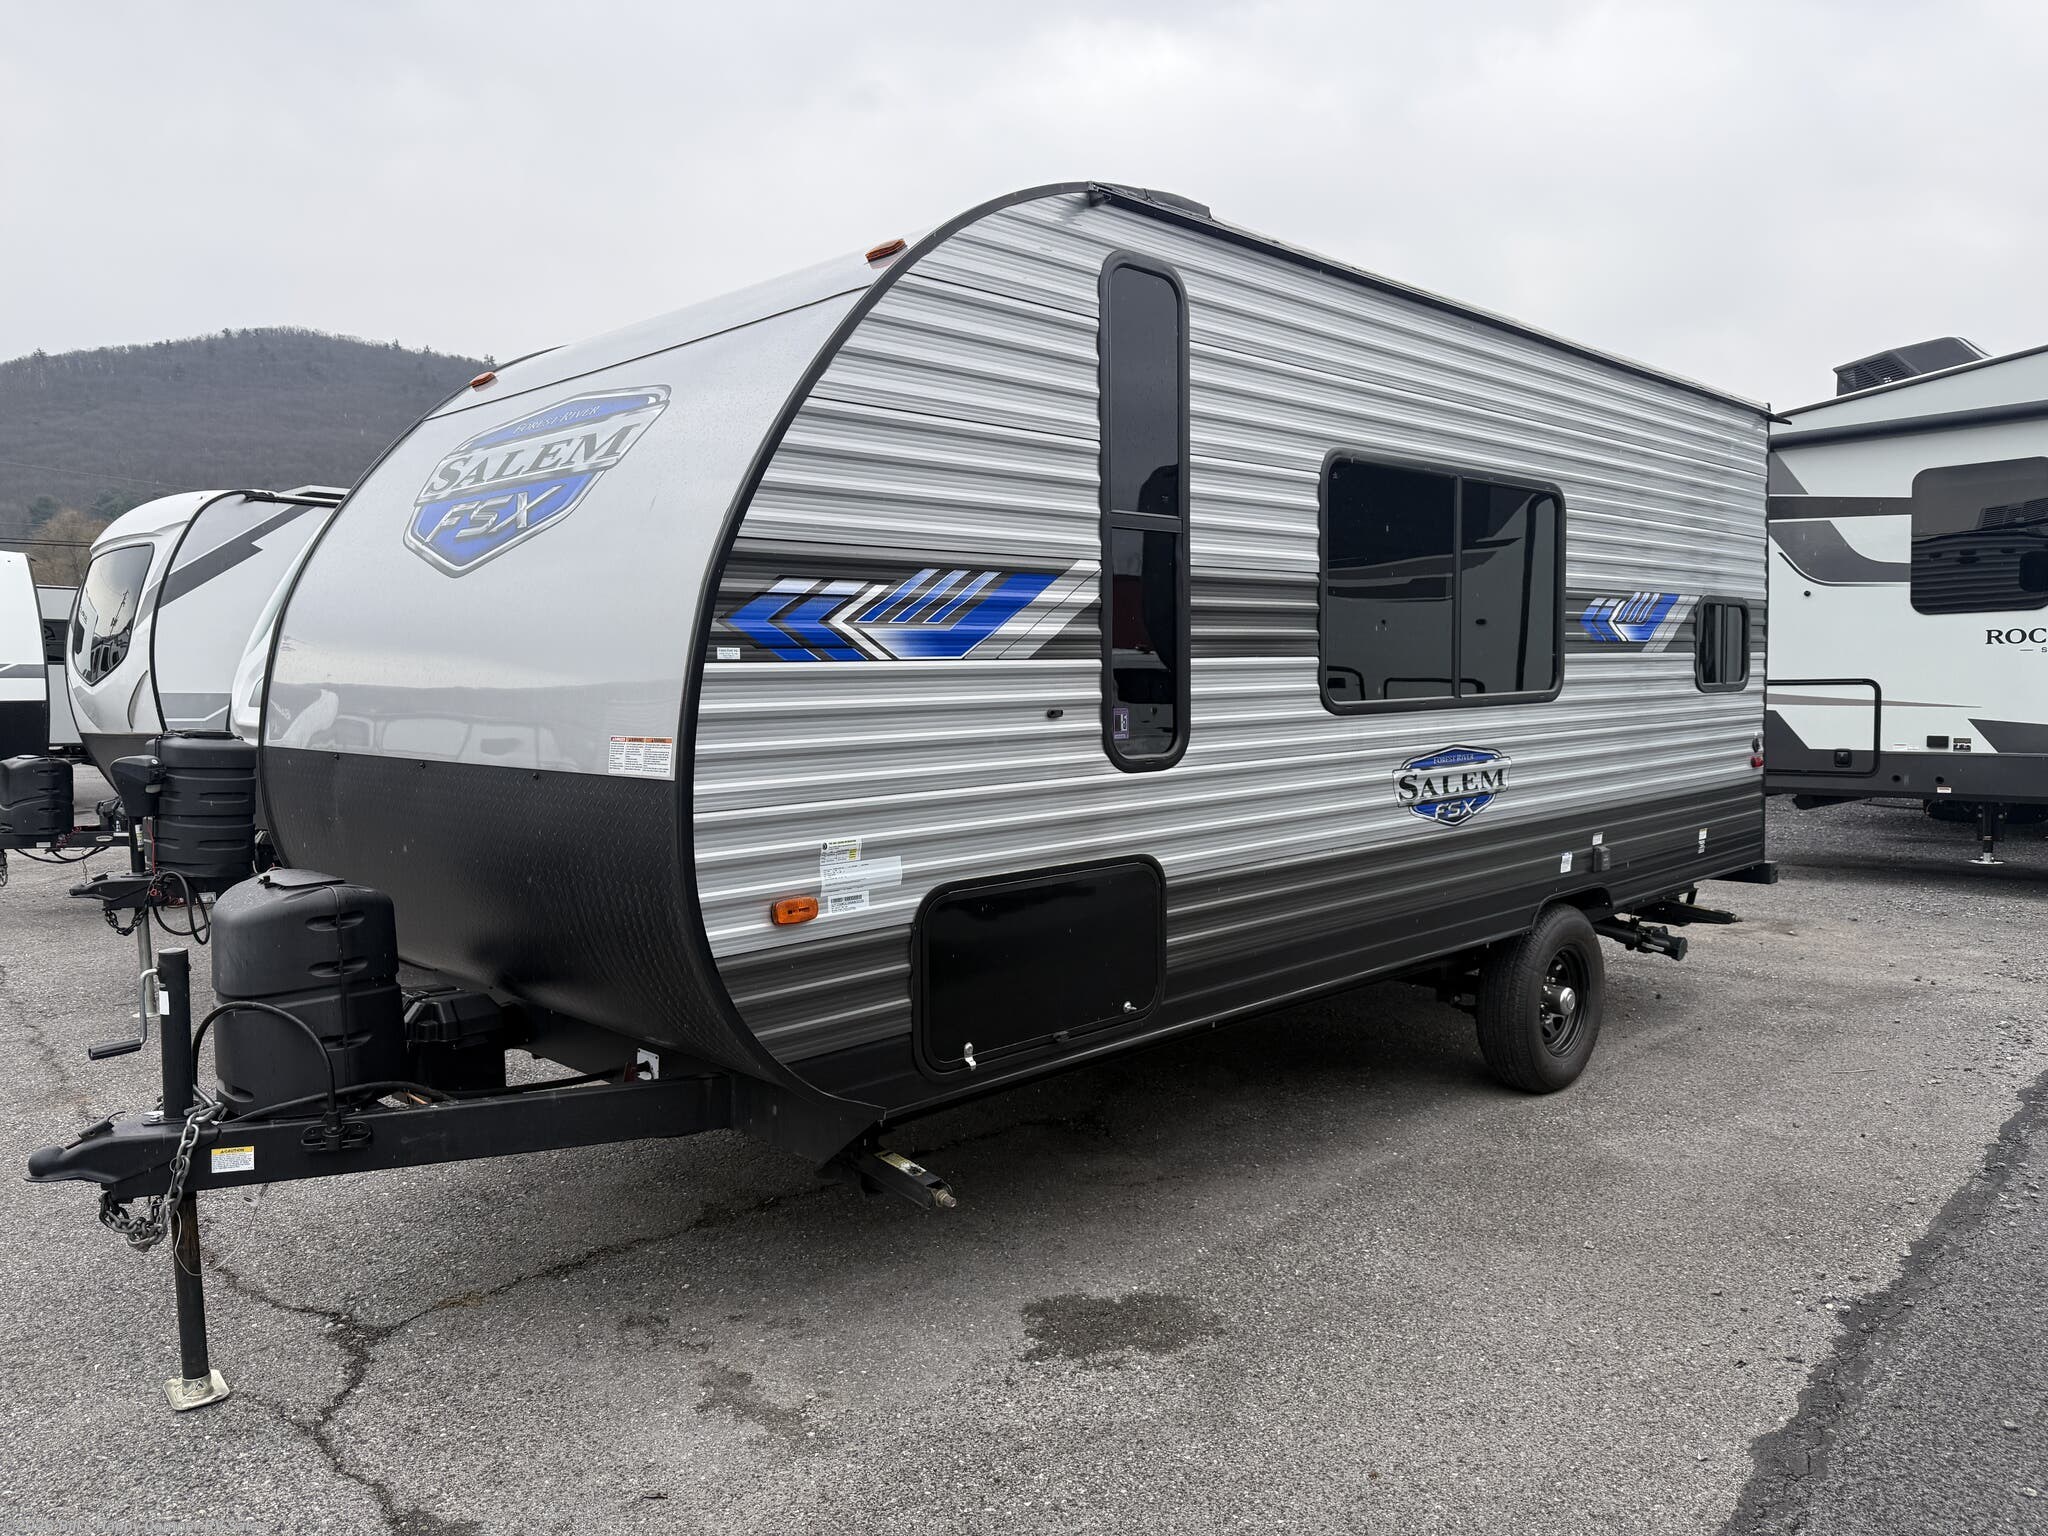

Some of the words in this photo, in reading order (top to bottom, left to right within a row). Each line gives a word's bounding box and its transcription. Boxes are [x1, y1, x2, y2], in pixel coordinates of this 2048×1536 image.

[560, 404, 600, 422] RIVER
[425, 422, 641, 495] SALEM
[424, 485, 566, 544] FSX
[1985, 627, 2047, 645] ROC
[1398, 767, 1504, 800] SALEM
[1434, 798, 1476, 819] FSX
